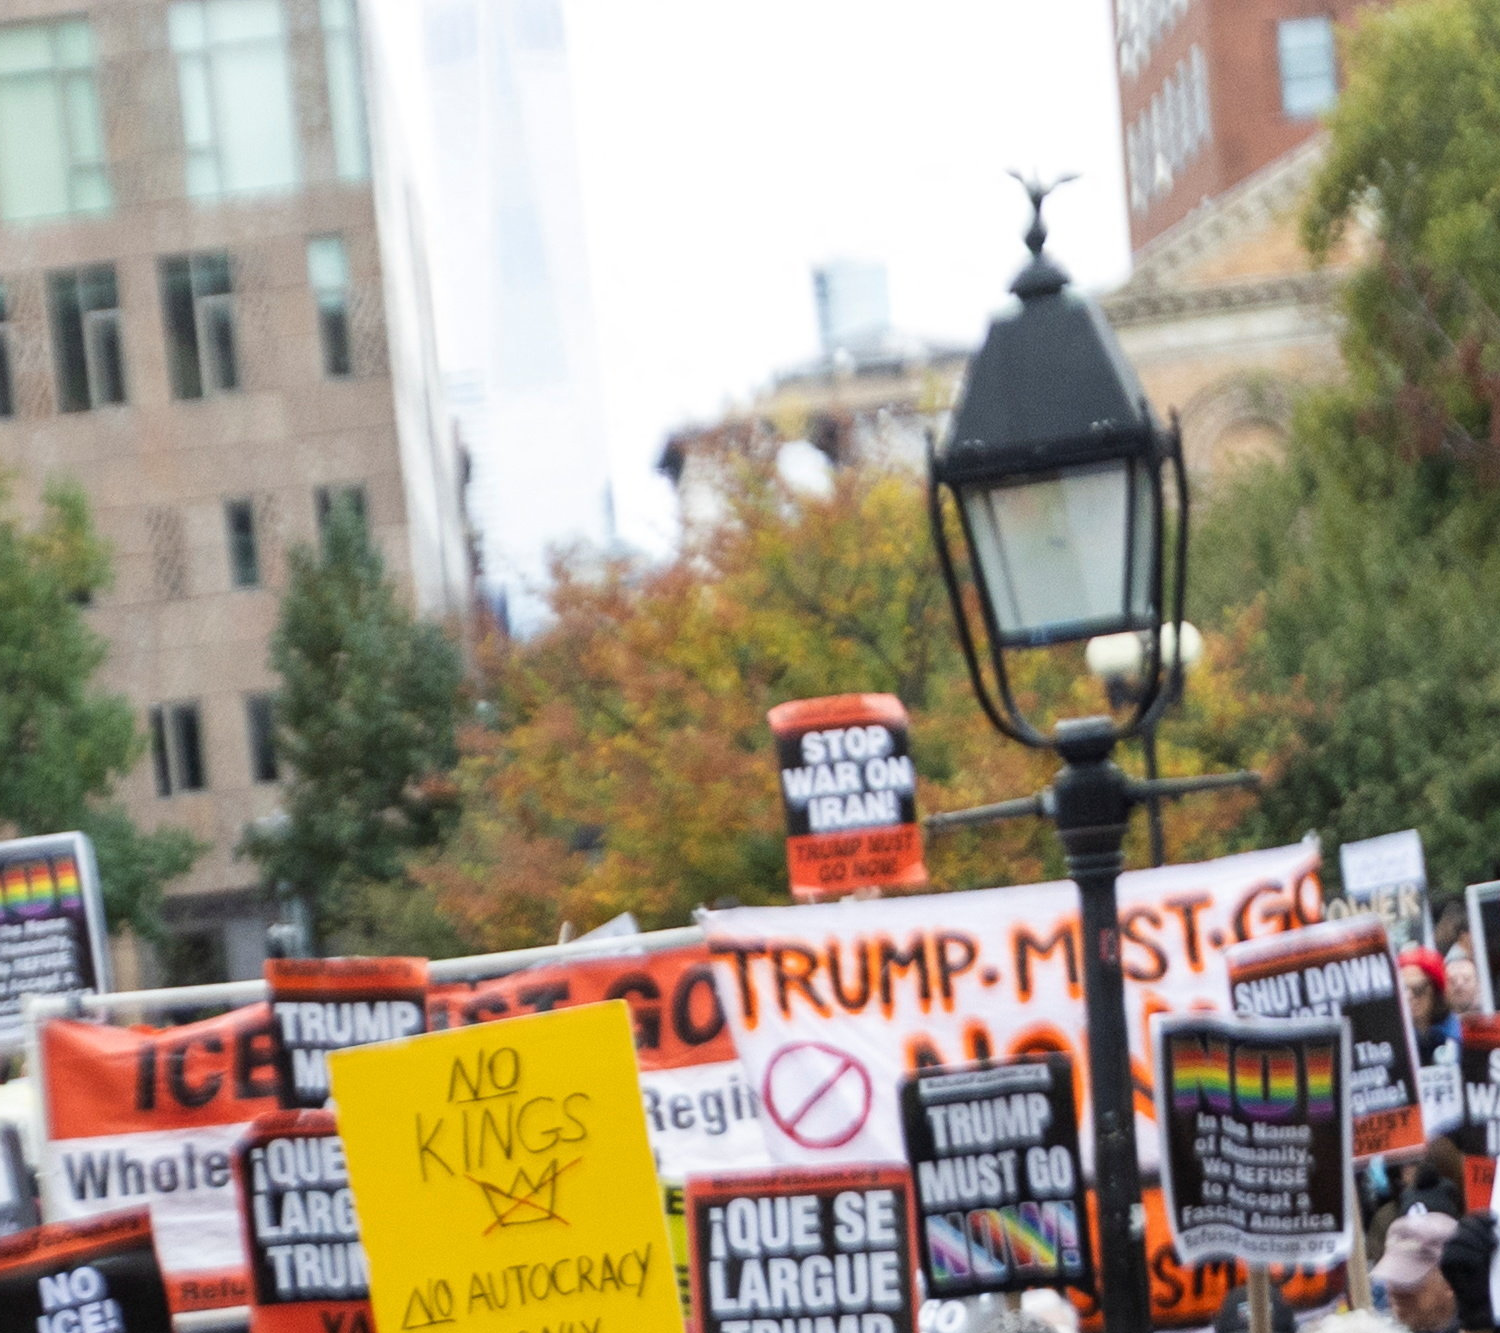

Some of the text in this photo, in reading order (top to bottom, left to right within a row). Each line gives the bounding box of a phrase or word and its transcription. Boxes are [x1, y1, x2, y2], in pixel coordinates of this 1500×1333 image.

[801, 724, 893, 766] STOP
[782, 754, 914, 803] WAR ON
[808, 789, 901, 830] IRAN!
[1304, 952, 1395, 1001] DOWN
[275, 1000, 423, 1046] TRUMP
[448, 1046, 522, 1103] NO
[415, 1092, 591, 1183] KINGS
[925, 1092, 1051, 1154] TRUMP
[1252, 1121, 1311, 1142] Name
[63, 1142, 232, 1202] Whole
[917, 1145, 1074, 1212] MUST GO
[1234, 1165, 1308, 1183] REFUSE
[253, 1187, 359, 1240] LARG
[708, 1188, 899, 1260] ¡QUE SE
[1250, 1210, 1335, 1229] America
[36, 1265, 103, 1311] NO
[402, 1242, 652, 1331] NO AUTOCRACY
[708, 1250, 901, 1318] LARGUE
